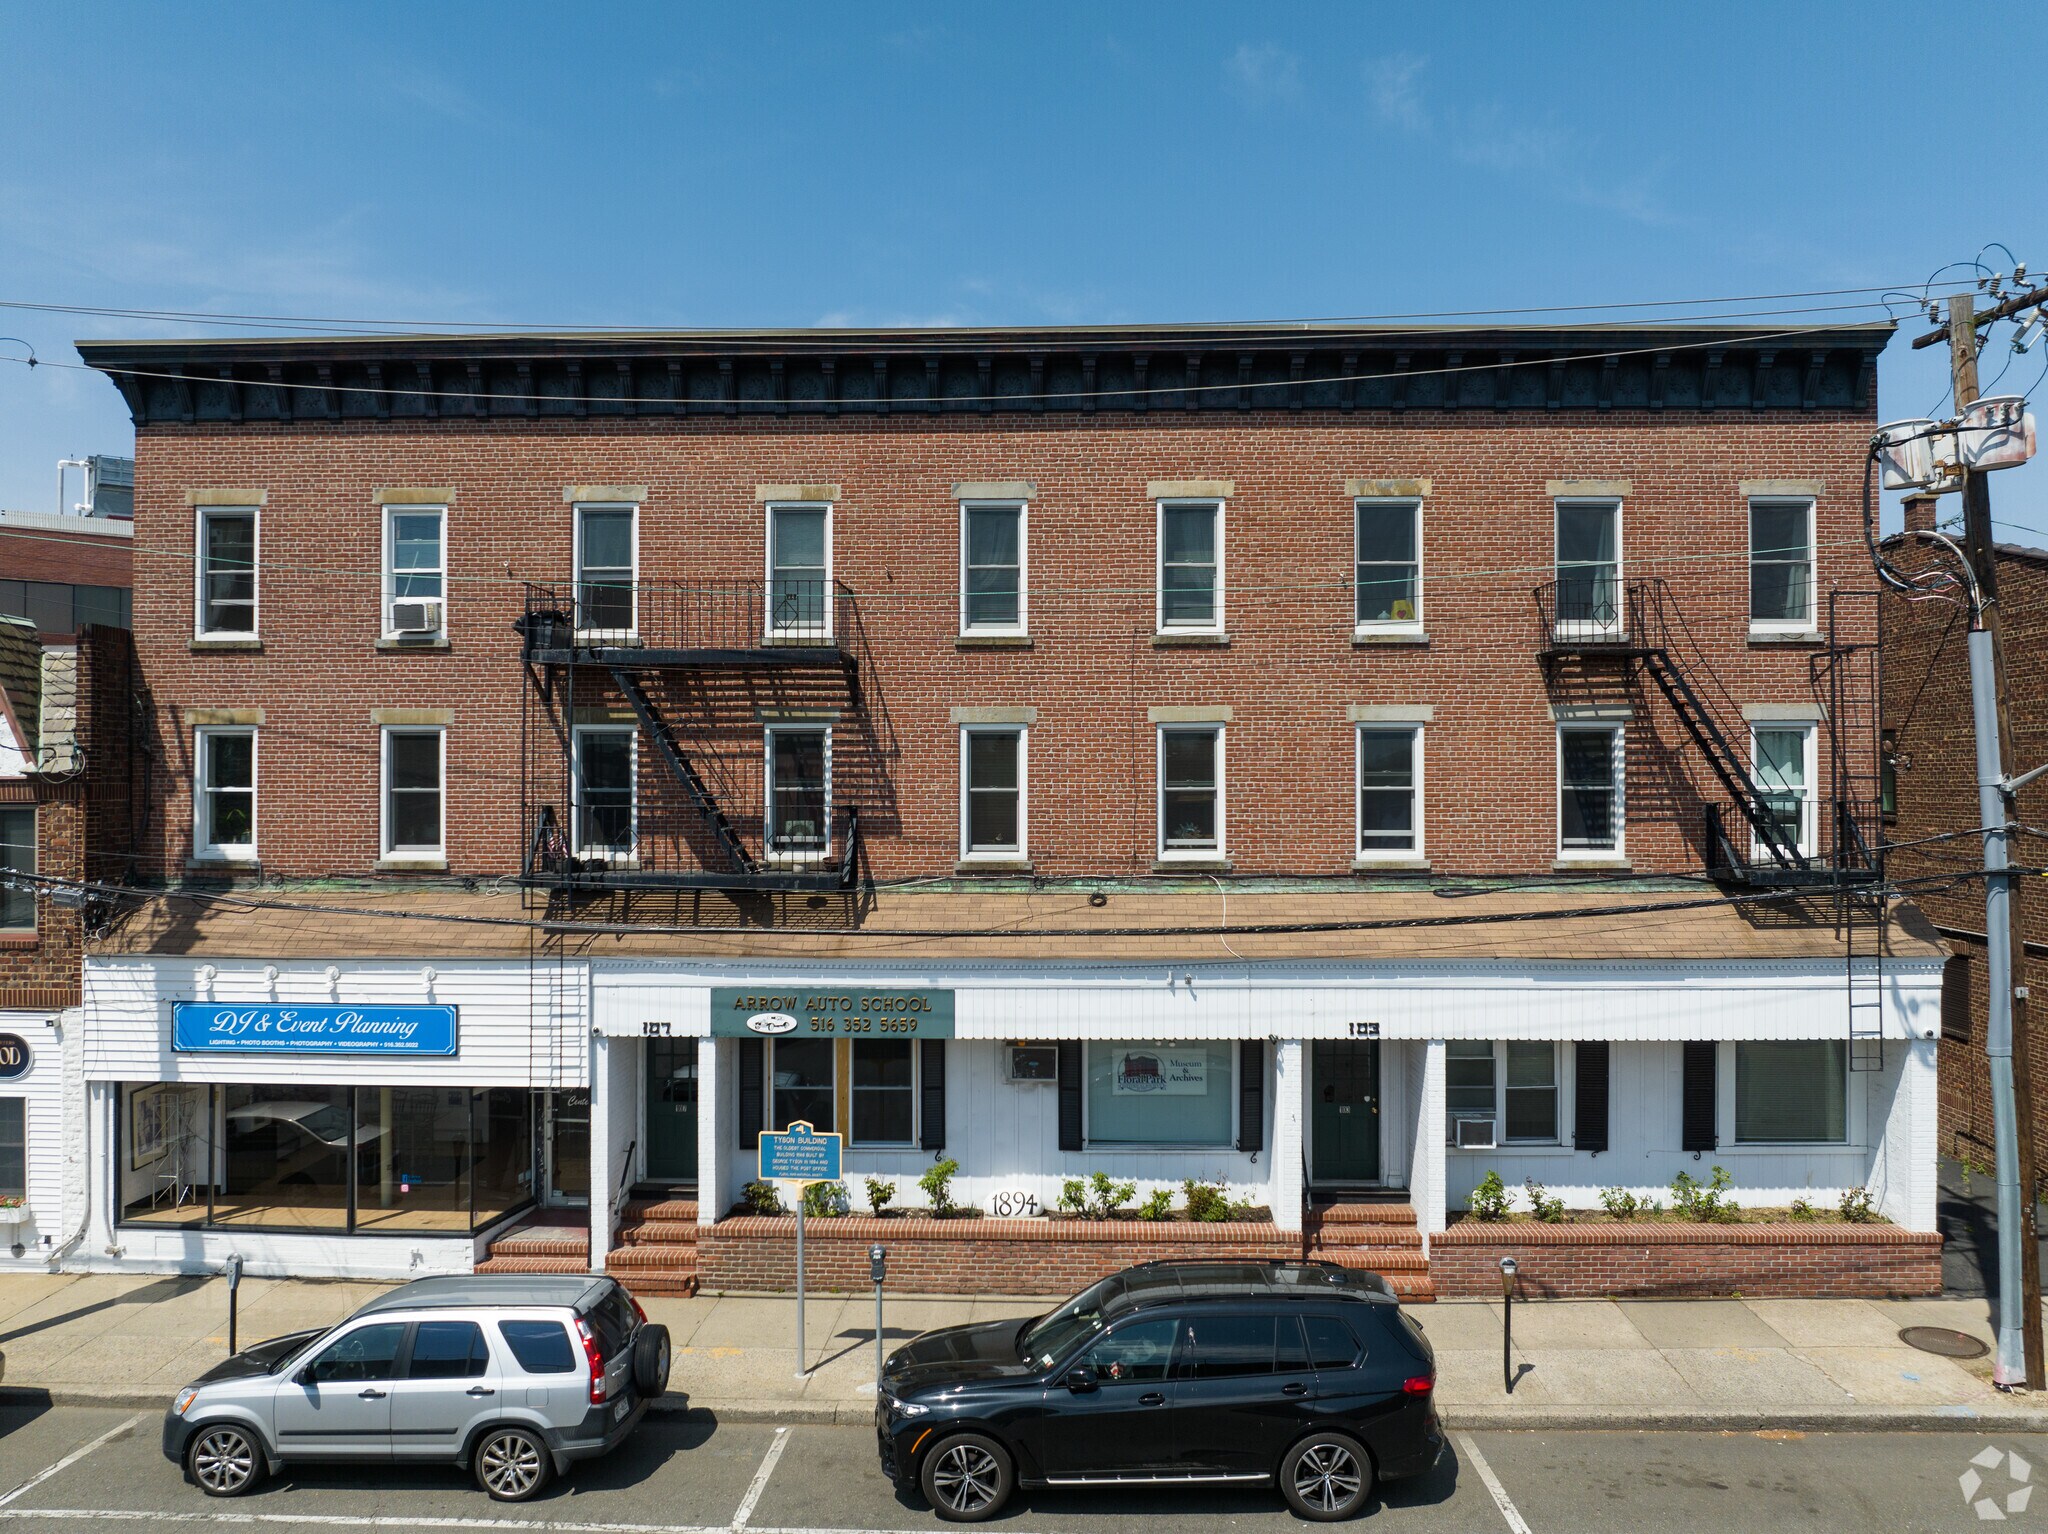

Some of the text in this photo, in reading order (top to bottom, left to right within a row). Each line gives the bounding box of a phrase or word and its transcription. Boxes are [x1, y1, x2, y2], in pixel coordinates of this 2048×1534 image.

[733, 996, 932, 1012] ARROW AUTO SCHOOL
[209, 1010, 419, 1040] DJ & Event Planning
[643, 1022, 671, 1035] 107
[810, 1017, 918, 1032] 516 352 5659
[1349, 1022, 1380, 1035] 103
[1117, 1074, 1167, 1084] Floral Park
[1169, 1074, 1203, 1082] Archives
[992, 1191, 1038, 1217] 1894
